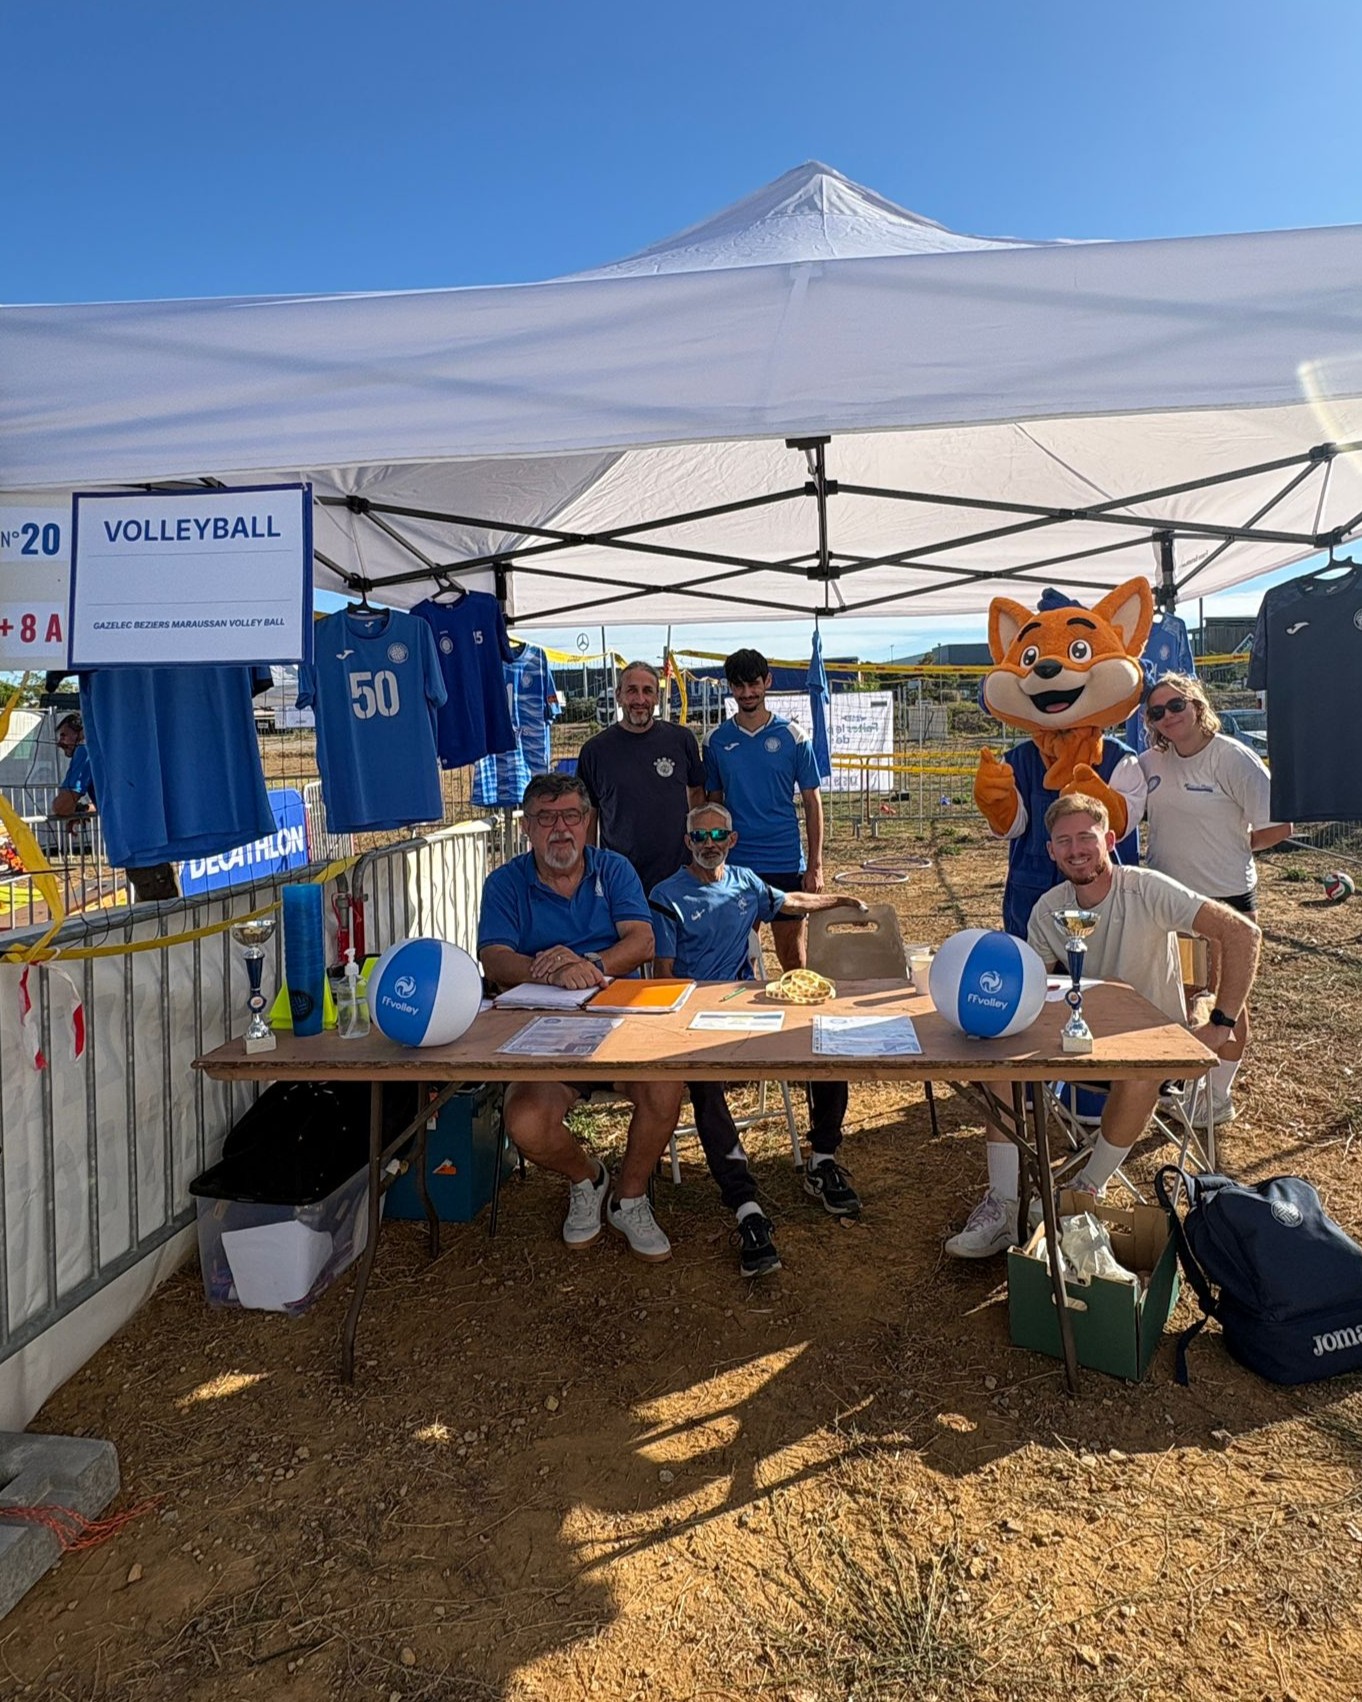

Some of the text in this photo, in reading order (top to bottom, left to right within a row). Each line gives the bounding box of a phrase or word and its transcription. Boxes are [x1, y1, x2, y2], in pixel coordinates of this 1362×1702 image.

[104, 515, 281, 542] VOLLEYBALL
[93, 617, 285, 630] GAZELEC BEZIERS MARAUSSAN VOLLEY BALL
[472, 630, 484, 645] 15
[349, 670, 400, 719] 50
[190, 825, 304, 880] DECATHLON
[967, 992, 1009, 1011] FFvolley
